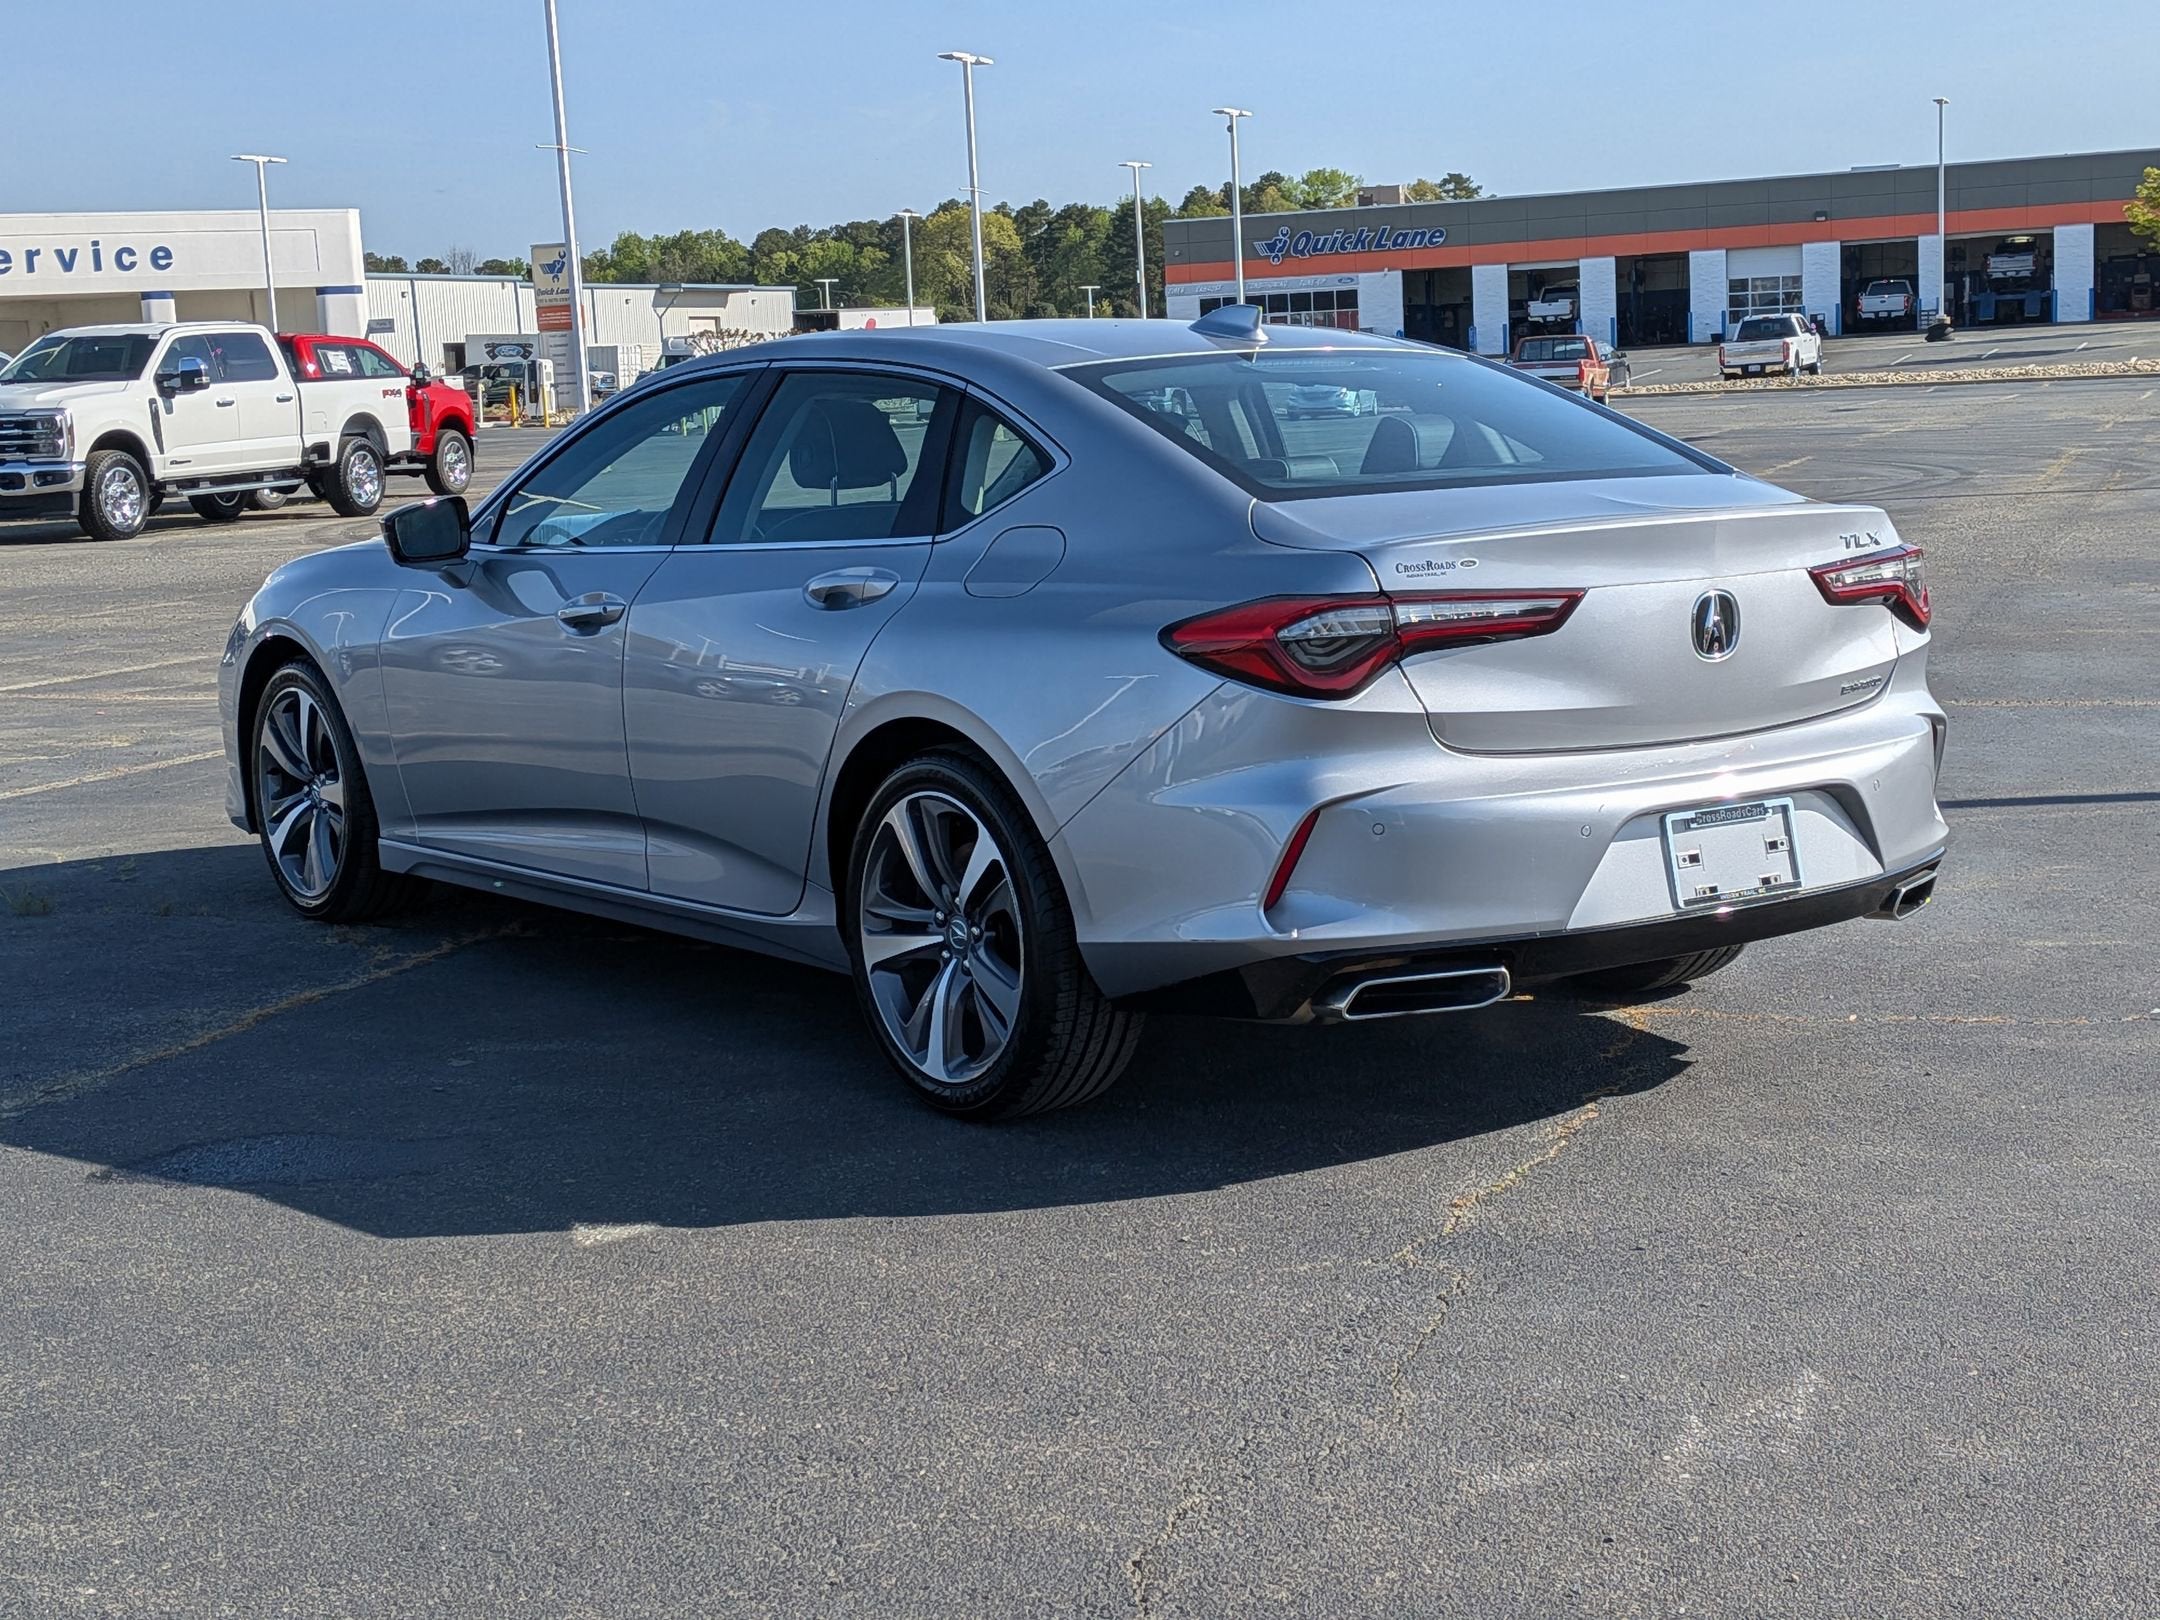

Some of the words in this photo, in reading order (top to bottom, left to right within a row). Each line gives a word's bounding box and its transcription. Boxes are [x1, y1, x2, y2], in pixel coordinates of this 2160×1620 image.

[1291, 227, 1375, 258] Quick
[1373, 225, 1447, 251] Lane
[555, 286, 570, 296] Lan
[1839, 531, 1881, 549] TLX
[1695, 806, 1765, 824] CrossRoadsCars
